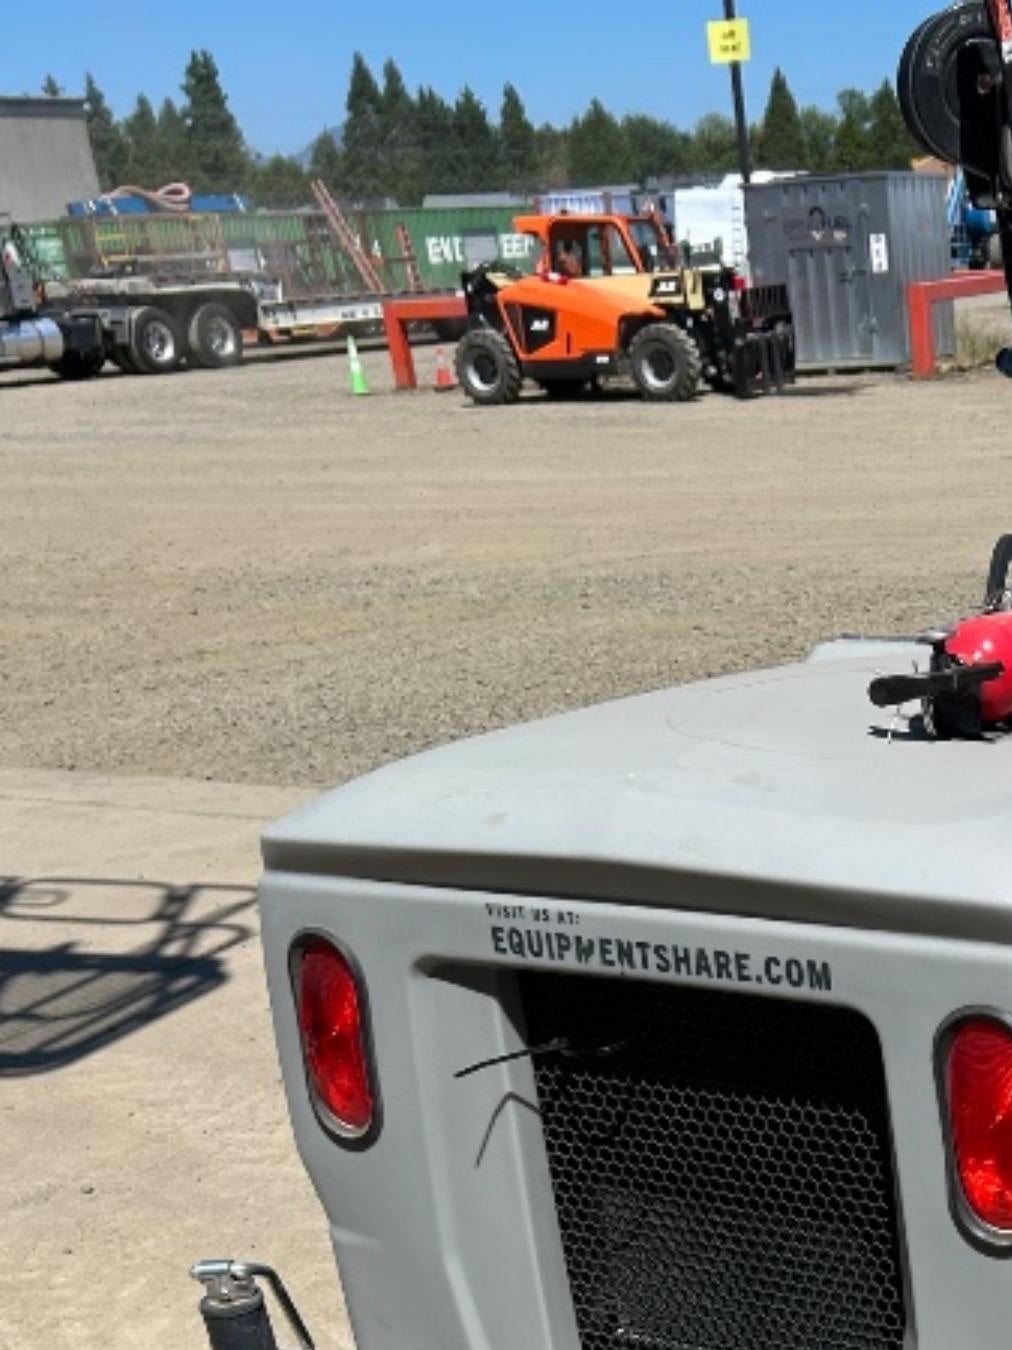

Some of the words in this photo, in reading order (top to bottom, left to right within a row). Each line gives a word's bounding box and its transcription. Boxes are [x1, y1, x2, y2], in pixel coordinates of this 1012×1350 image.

[485, 903, 525, 920] VISIT
[531, 908, 550, 922] US
[491, 926, 833, 992] EQUIPMENTSHARE.COM
